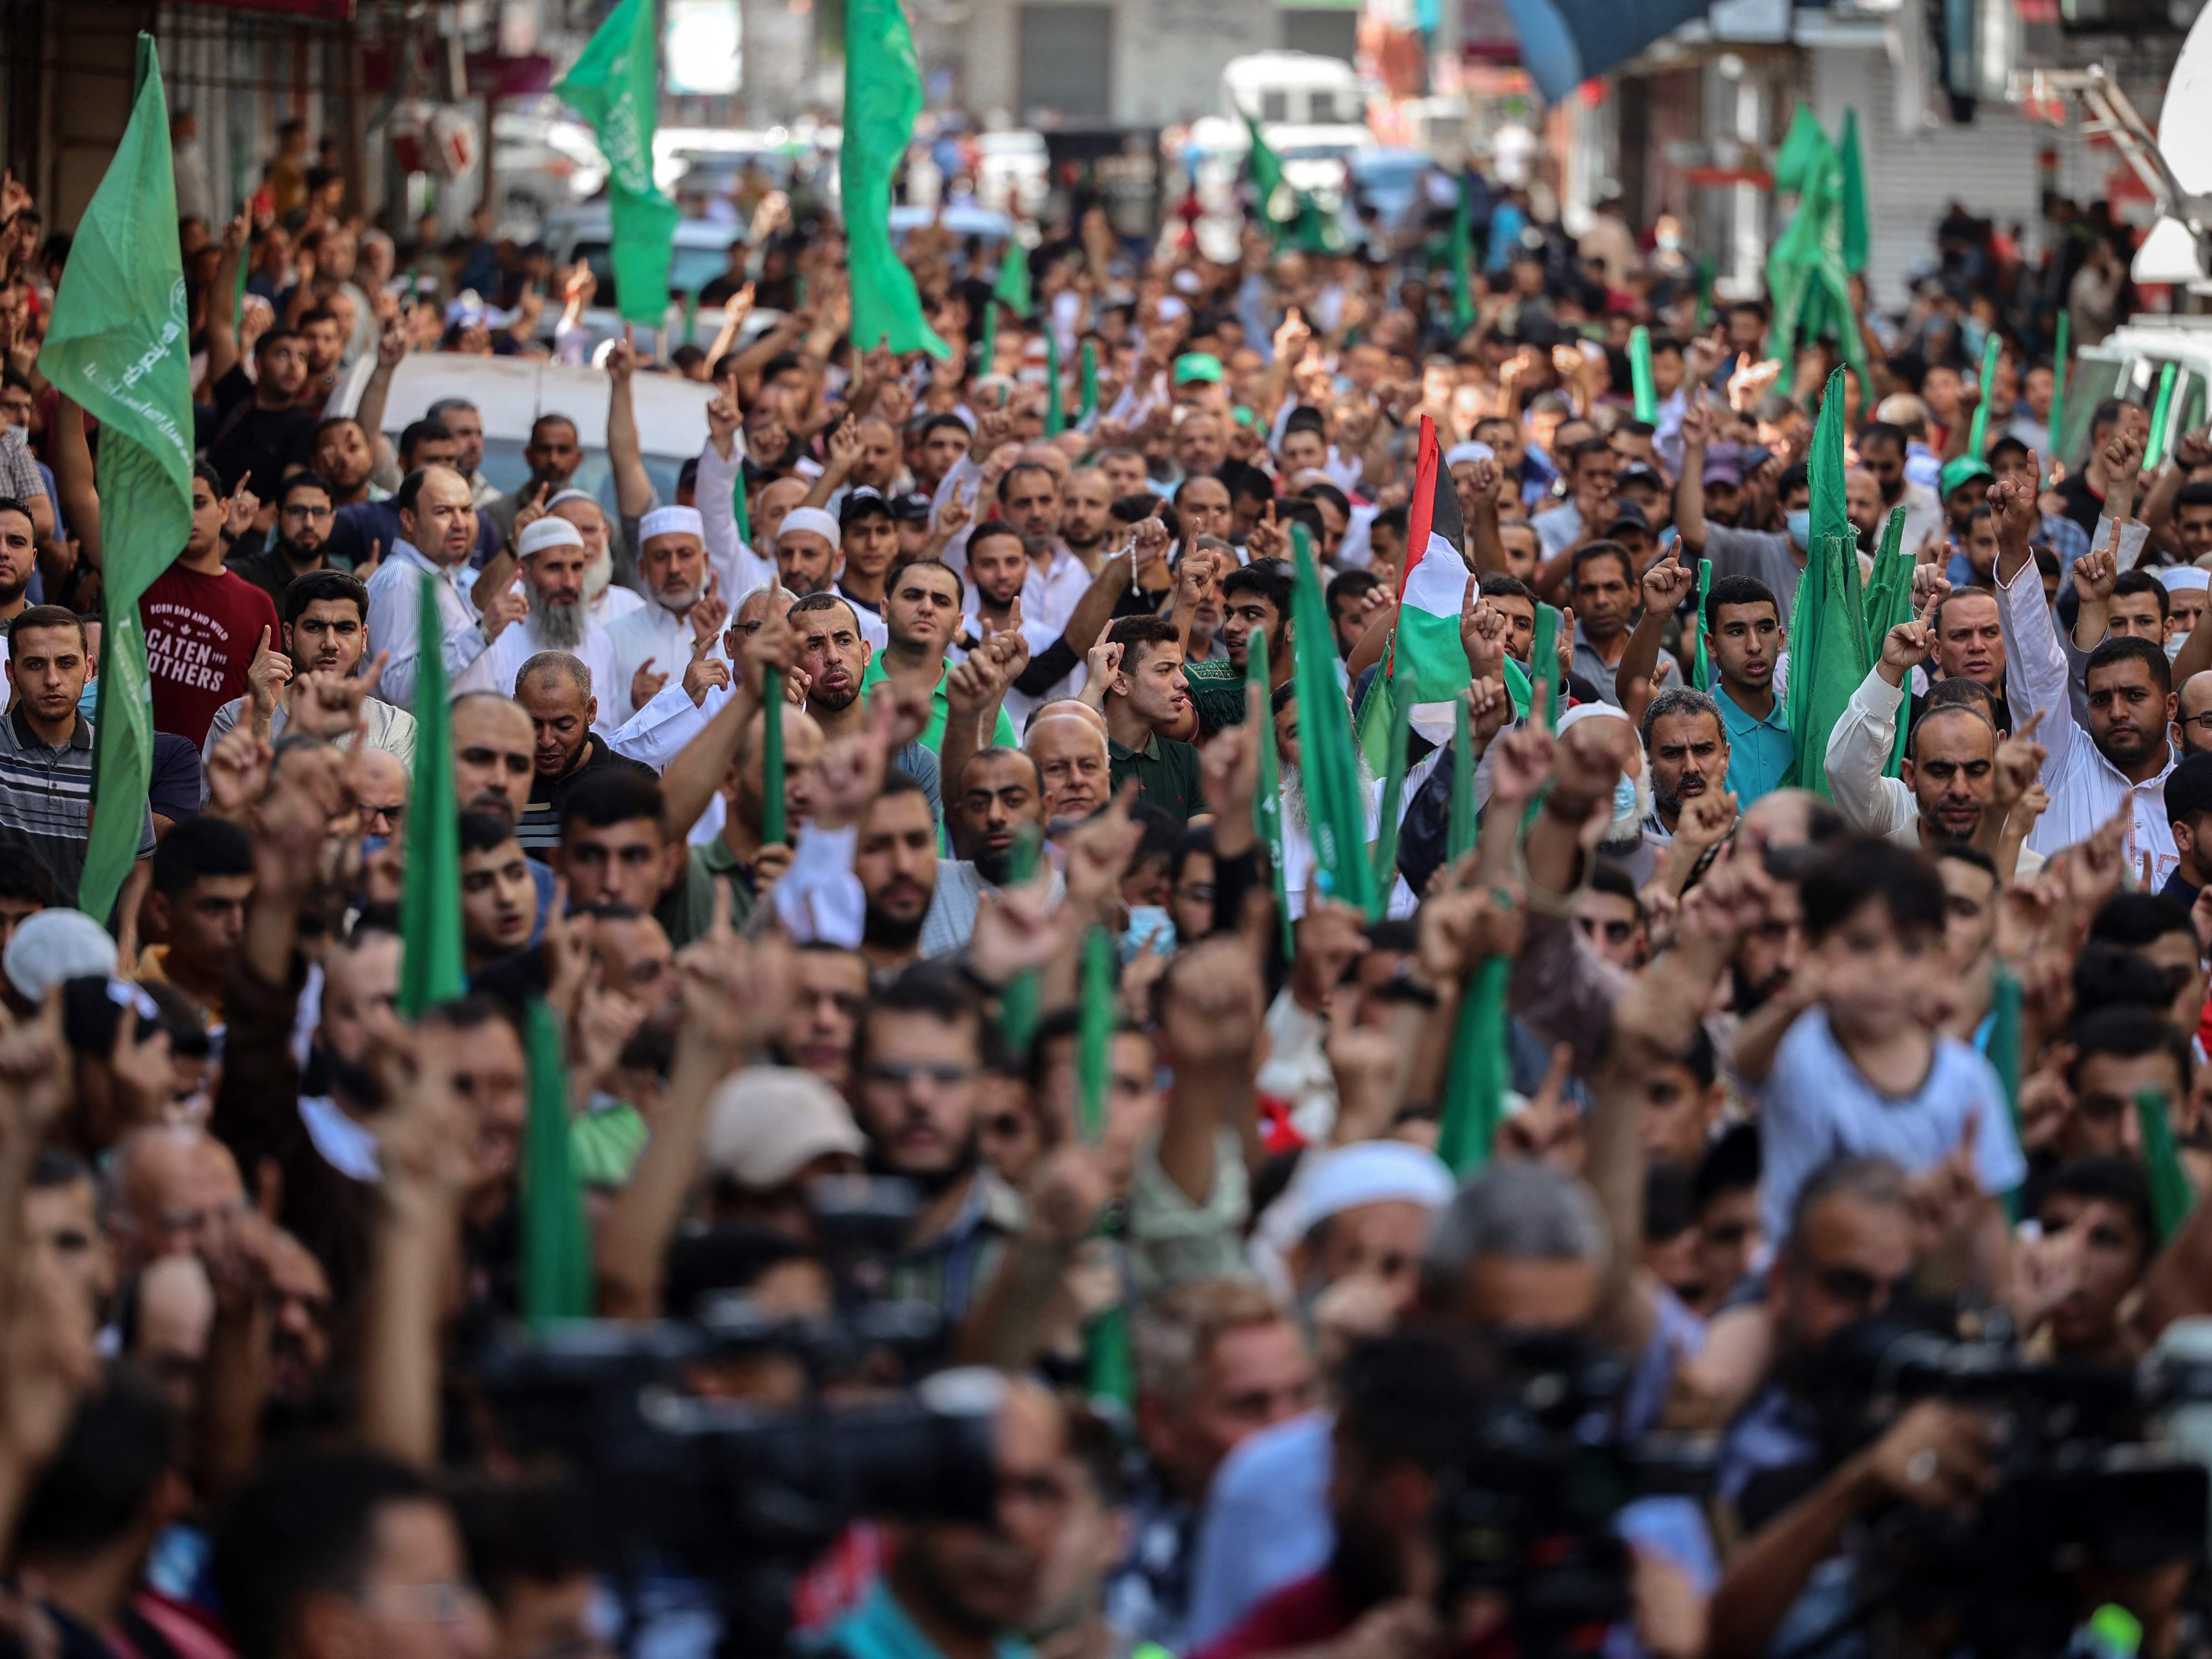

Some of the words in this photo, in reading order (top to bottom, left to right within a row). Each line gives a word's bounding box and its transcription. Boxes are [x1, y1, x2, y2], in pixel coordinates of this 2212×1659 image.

[151, 603, 173, 614] BORN
[174, 605, 191, 617] BAD
[191, 611, 209, 625] AND
[210, 620, 228, 641] WILD
[147, 628, 212, 665] CATEN
[148, 651, 225, 692] OTHERS
